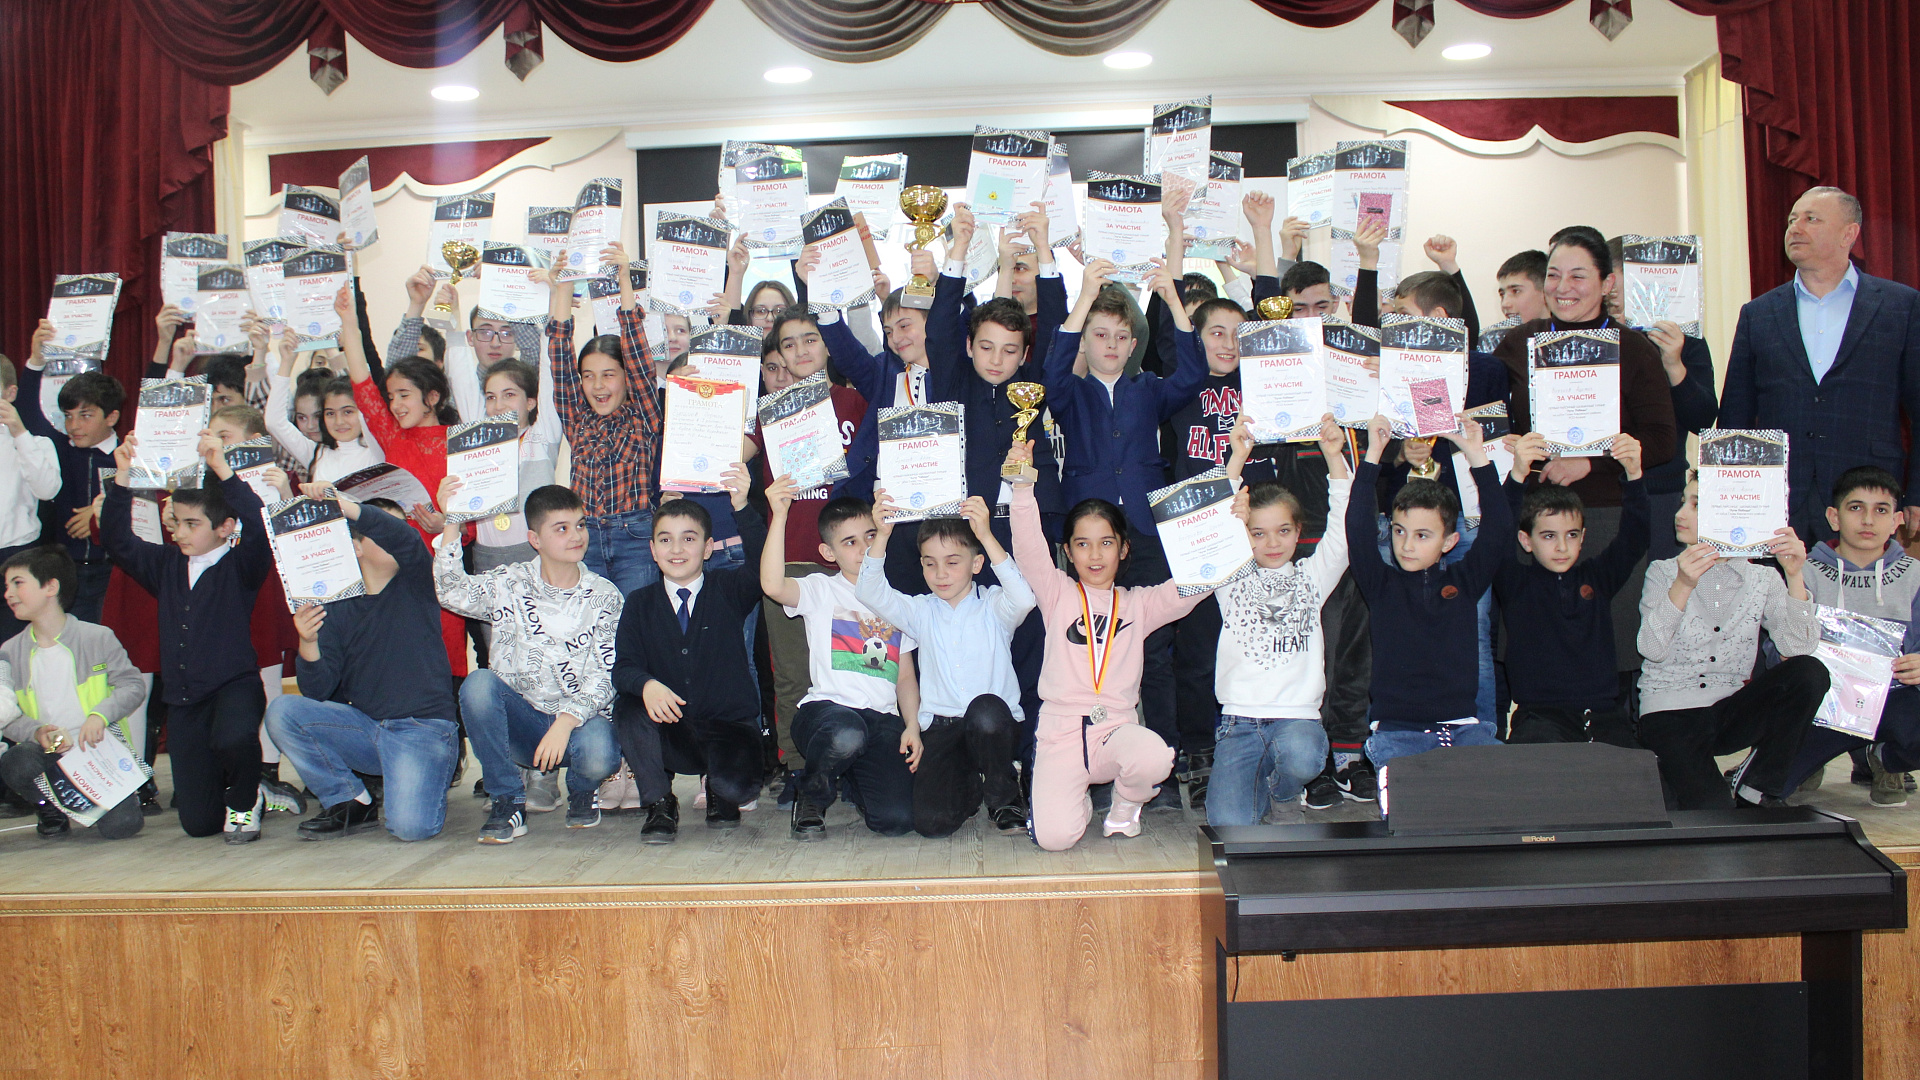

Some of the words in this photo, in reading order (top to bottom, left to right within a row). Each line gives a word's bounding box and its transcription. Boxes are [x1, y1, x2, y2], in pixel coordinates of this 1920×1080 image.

[1166, 132, 1197, 142] ГАМОТА
[989, 158, 1027, 167] ГРАМОТА
[1302, 174, 1333, 186] ГРАМОТА
[753, 183, 788, 192] ГРАМОТА
[1104, 204, 1142, 213] ГРАМОТА
[298, 214, 328, 225] ГРАМОТА
[820, 236, 848, 251] ГРАМОТА
[672, 245, 708, 256] ГРАМОТА
[832, 259, 848, 268] МЕСТО
[300, 277, 333, 286] ГРАМОТА
[64, 297, 97, 306] ГРАМОТА
[607, 294, 640, 306] ГРАА
[704, 357, 742, 366] ГРАМОТА
[1260, 358, 1302, 367] ГРАМОТА
[1330, 352, 1362, 366] ГРАМОТА
[1400, 353, 1442, 363] ГРАМОТА
[1554, 370, 1597, 379] ГРАМОТА
[1339, 376, 1357, 385] МЕСТО
[780, 410, 817, 430] ГРАОТА
[898, 440, 939, 450] ГРАМОТА
[464, 448, 501, 461] ГРАМОТА
[475, 467, 500, 476] УЧАСТИЕ
[1718, 470, 1761, 478] ГРАМОТА
[1177, 508, 1218, 528] ГРАМОТА
[294, 526, 331, 542] ГРАМОТА
[1196, 532, 1218, 544] МЕСТО
[311, 547, 336, 558] УЧАСТИЕ
[1842, 573, 1870, 588] WALK
[1873, 572, 1894, 586] HE
[522, 596, 545, 635] NOW
[1273, 635, 1310, 652] HEART
[558, 661, 581, 694] NOW
[88, 760, 106, 781] УЧАСТИЕ
[73, 770, 102, 800] ГРАМОТА
